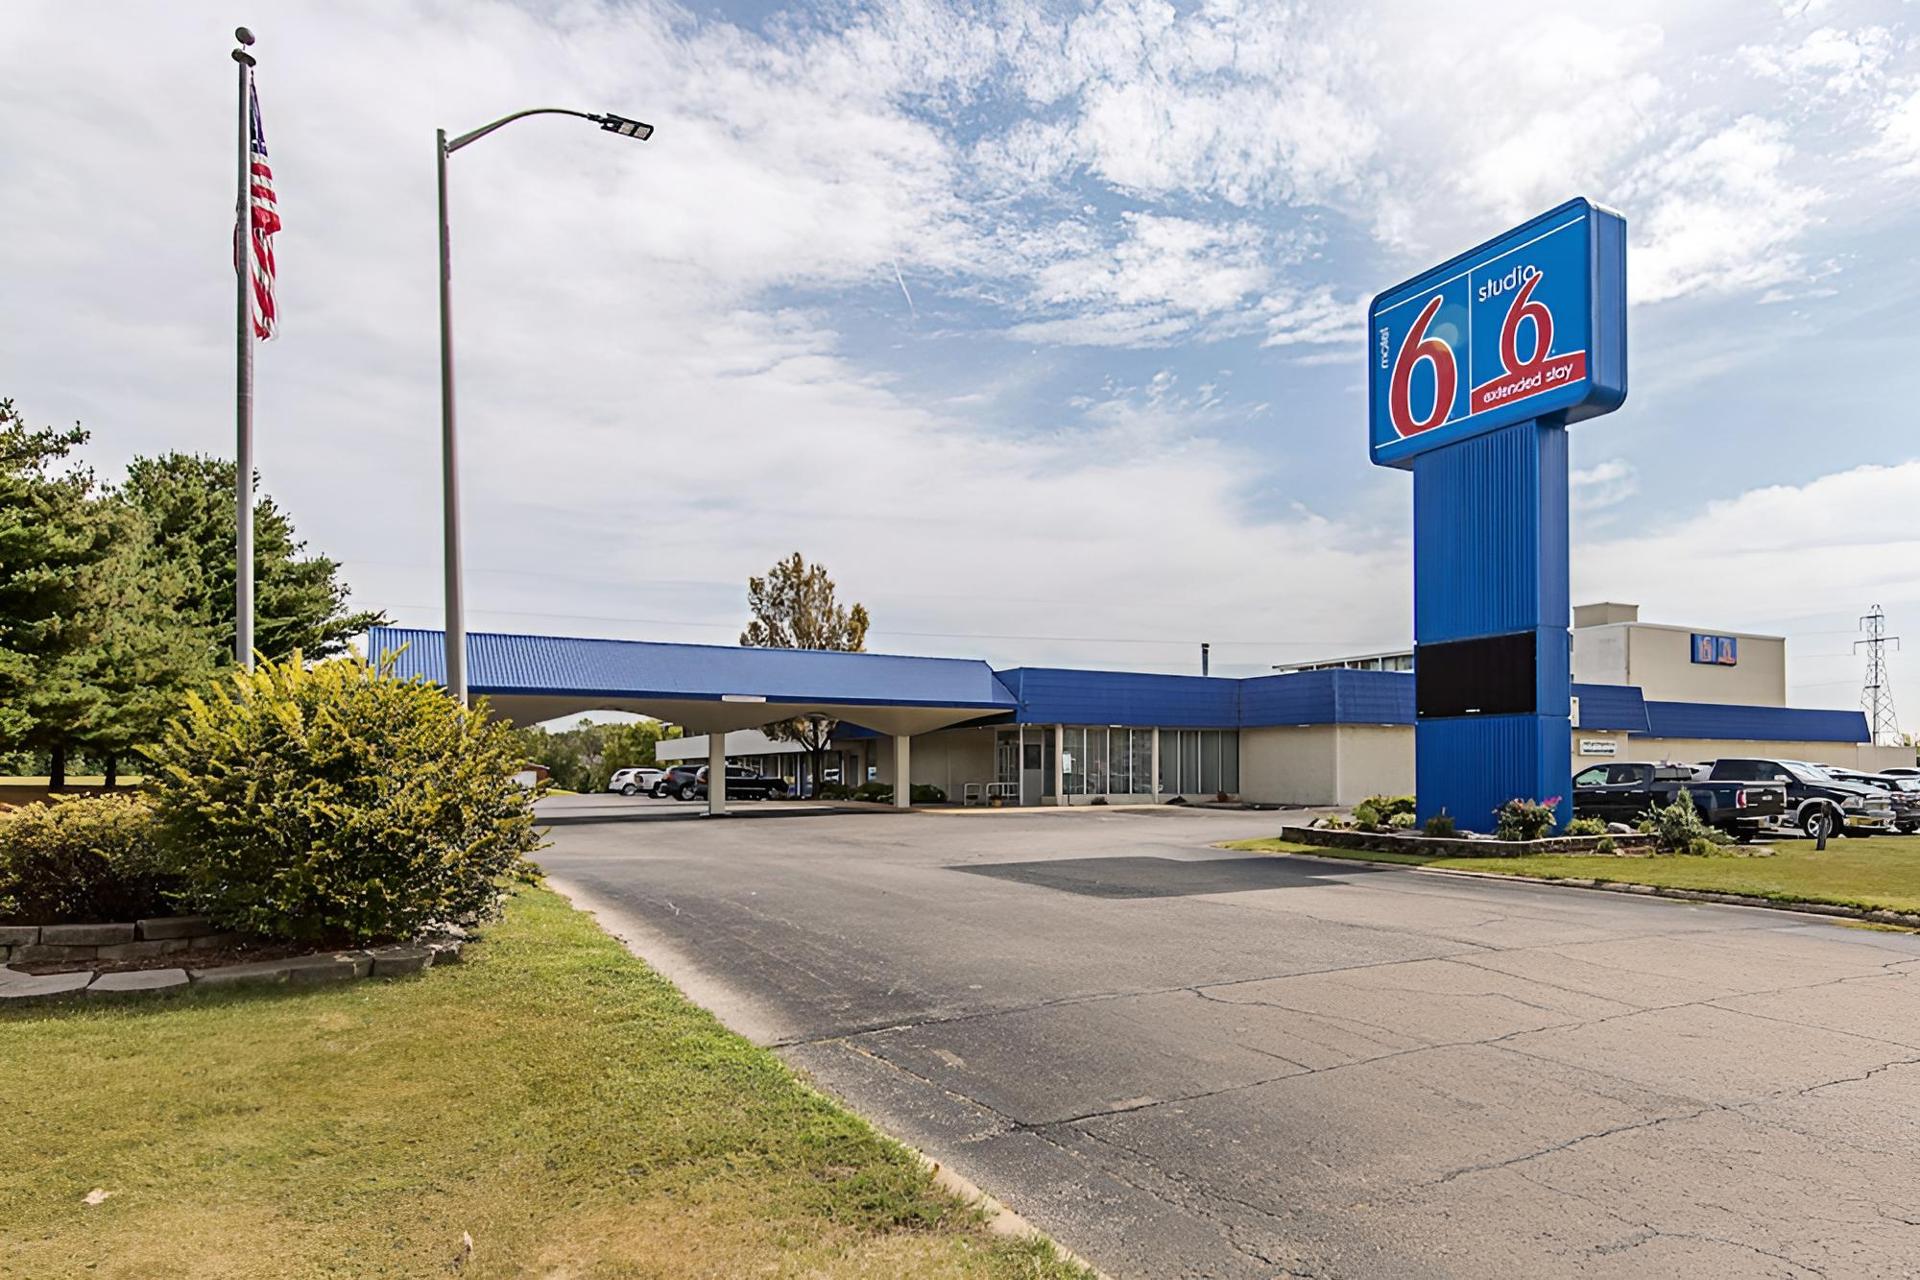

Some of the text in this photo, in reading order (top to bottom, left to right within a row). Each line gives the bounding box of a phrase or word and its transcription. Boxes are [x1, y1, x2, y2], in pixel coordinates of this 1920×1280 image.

[1479, 265, 1536, 302] studio
[1500, 271, 1554, 377] 6
[1380, 327, 1389, 369] motel
[1389, 295, 1458, 438] 6
[1484, 363, 1573, 403] extended stay
